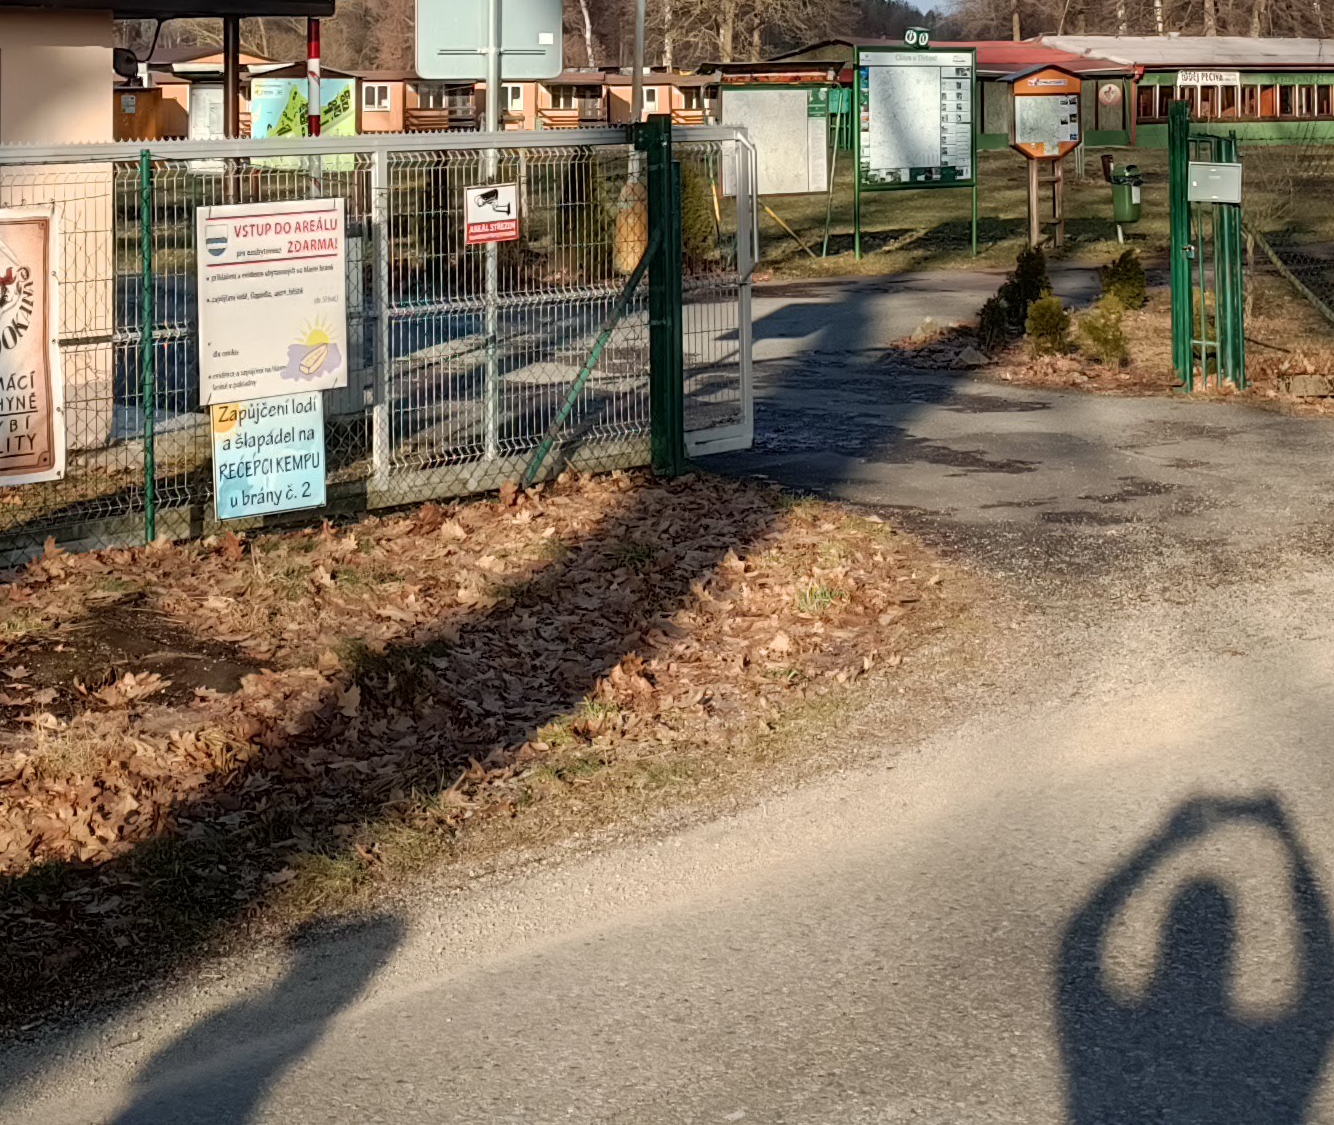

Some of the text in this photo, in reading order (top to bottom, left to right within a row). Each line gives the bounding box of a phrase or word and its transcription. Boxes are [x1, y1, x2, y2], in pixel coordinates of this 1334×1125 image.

[234, 216, 338, 238] VSTUP DO AREÁLU
[287, 238, 338, 254] ZDARMA!
[218, 395, 317, 426] Zapůjčení lodí
[222, 426, 315, 453] a šlapádel na
[276, 452, 320, 473] KEMPU
[230, 481, 312, 508] u brány č. 2
